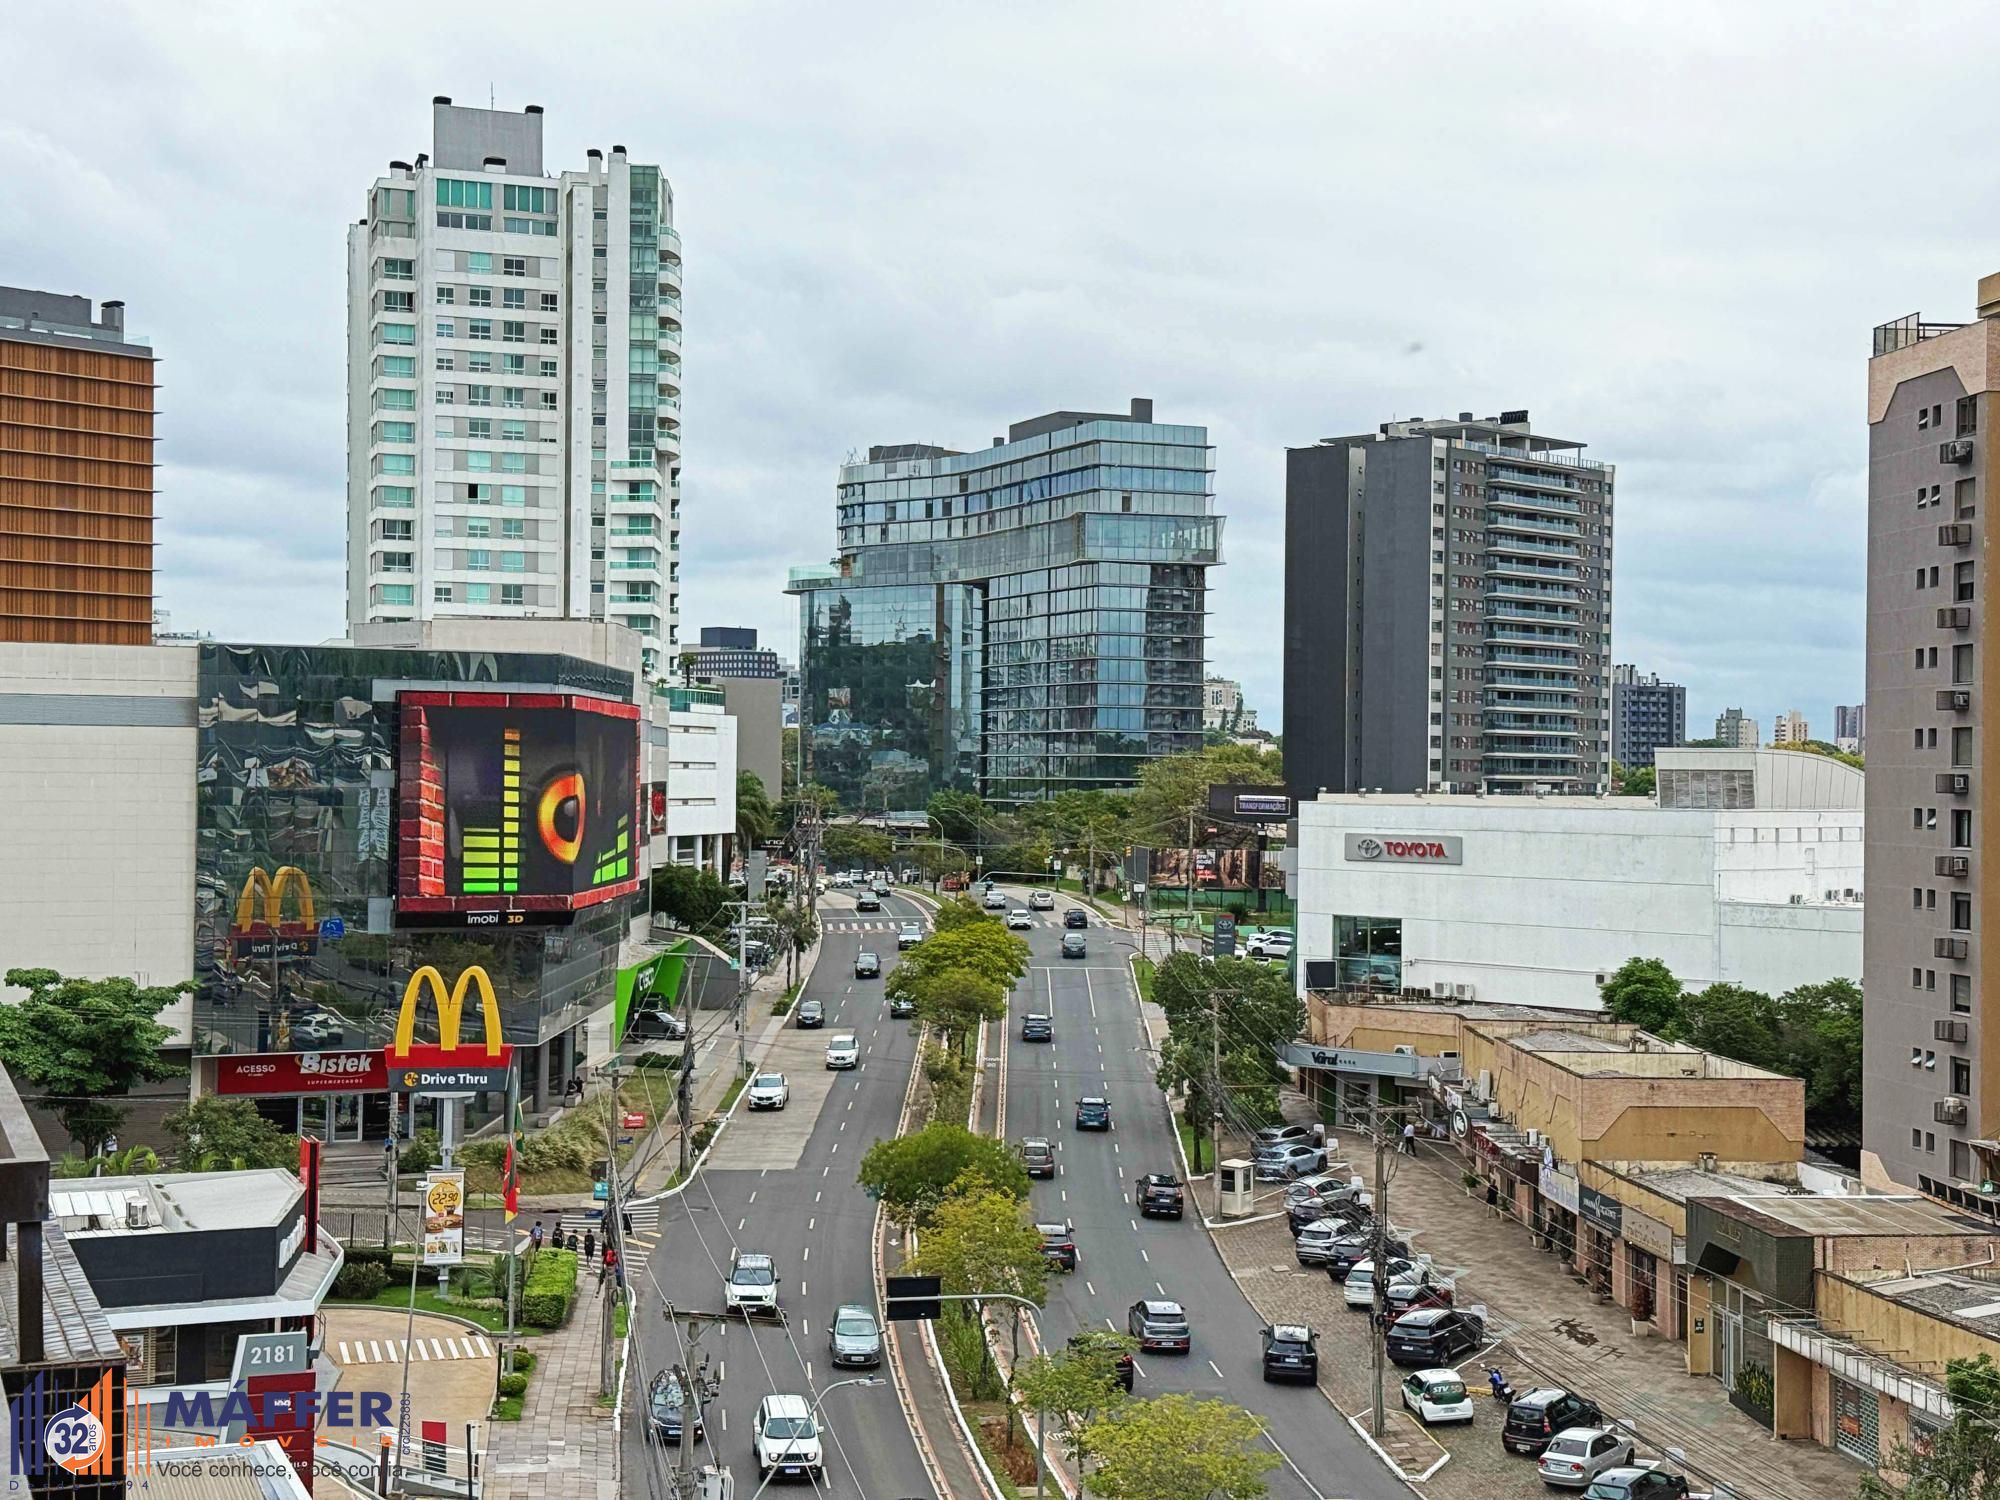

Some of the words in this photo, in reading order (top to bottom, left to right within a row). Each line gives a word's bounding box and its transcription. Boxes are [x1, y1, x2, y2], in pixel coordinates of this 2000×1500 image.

[1384, 841, 1448, 858] TOYOTA
[507, 915, 524, 924] 3D
[235, 1064, 277, 1074] ACESSO
[300, 1053, 372, 1074] Bistek
[421, 1073, 456, 1085] Drive
[457, 1073, 488, 1085] Thru
[250, 1344, 295, 1364] 2181
[1433, 1385, 1449, 1393] STV
